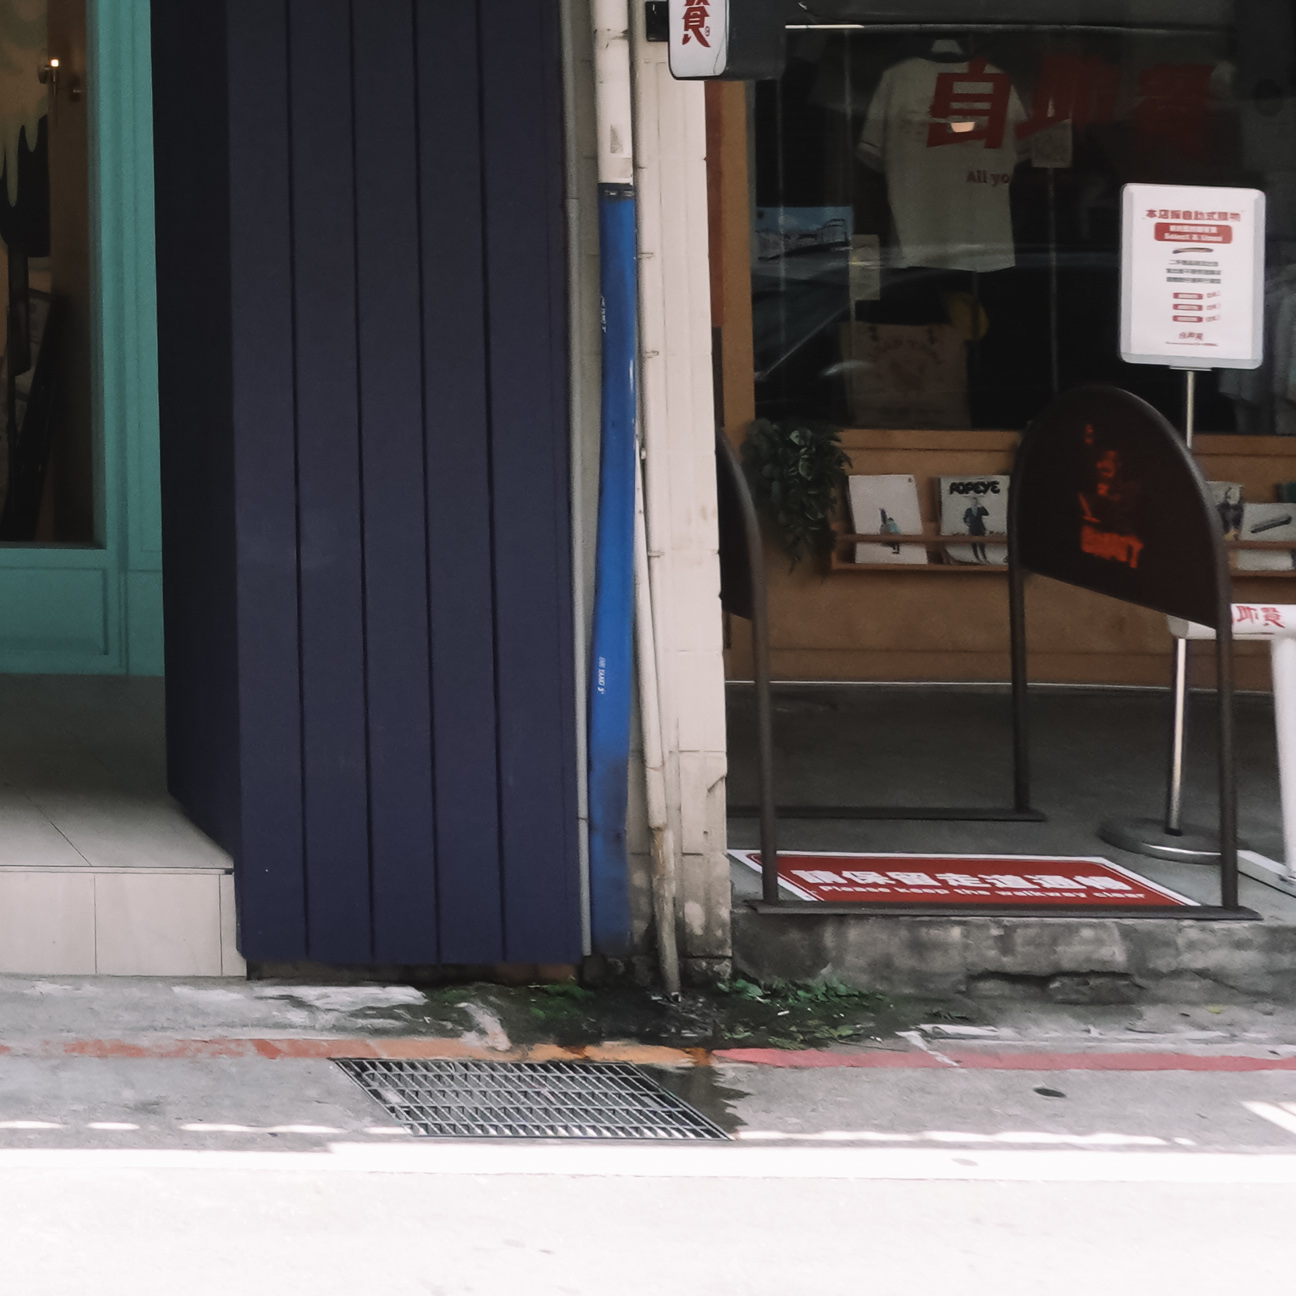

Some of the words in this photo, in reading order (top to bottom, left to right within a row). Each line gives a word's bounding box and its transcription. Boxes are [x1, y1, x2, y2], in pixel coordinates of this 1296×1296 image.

[966, 170, 988, 184] All
[950, 480, 1001, 495] POPEYE
[1231, 605, 1286, 628] 助餐
[791, 869, 1133, 891] 請保留走道通暢
[818, 885, 891, 894] Please
[895, 887, 950, 895] keep
[954, 888, 991, 896] the
[996, 890, 1088, 899] walkway
[1093, 891, 1146, 899] clear
